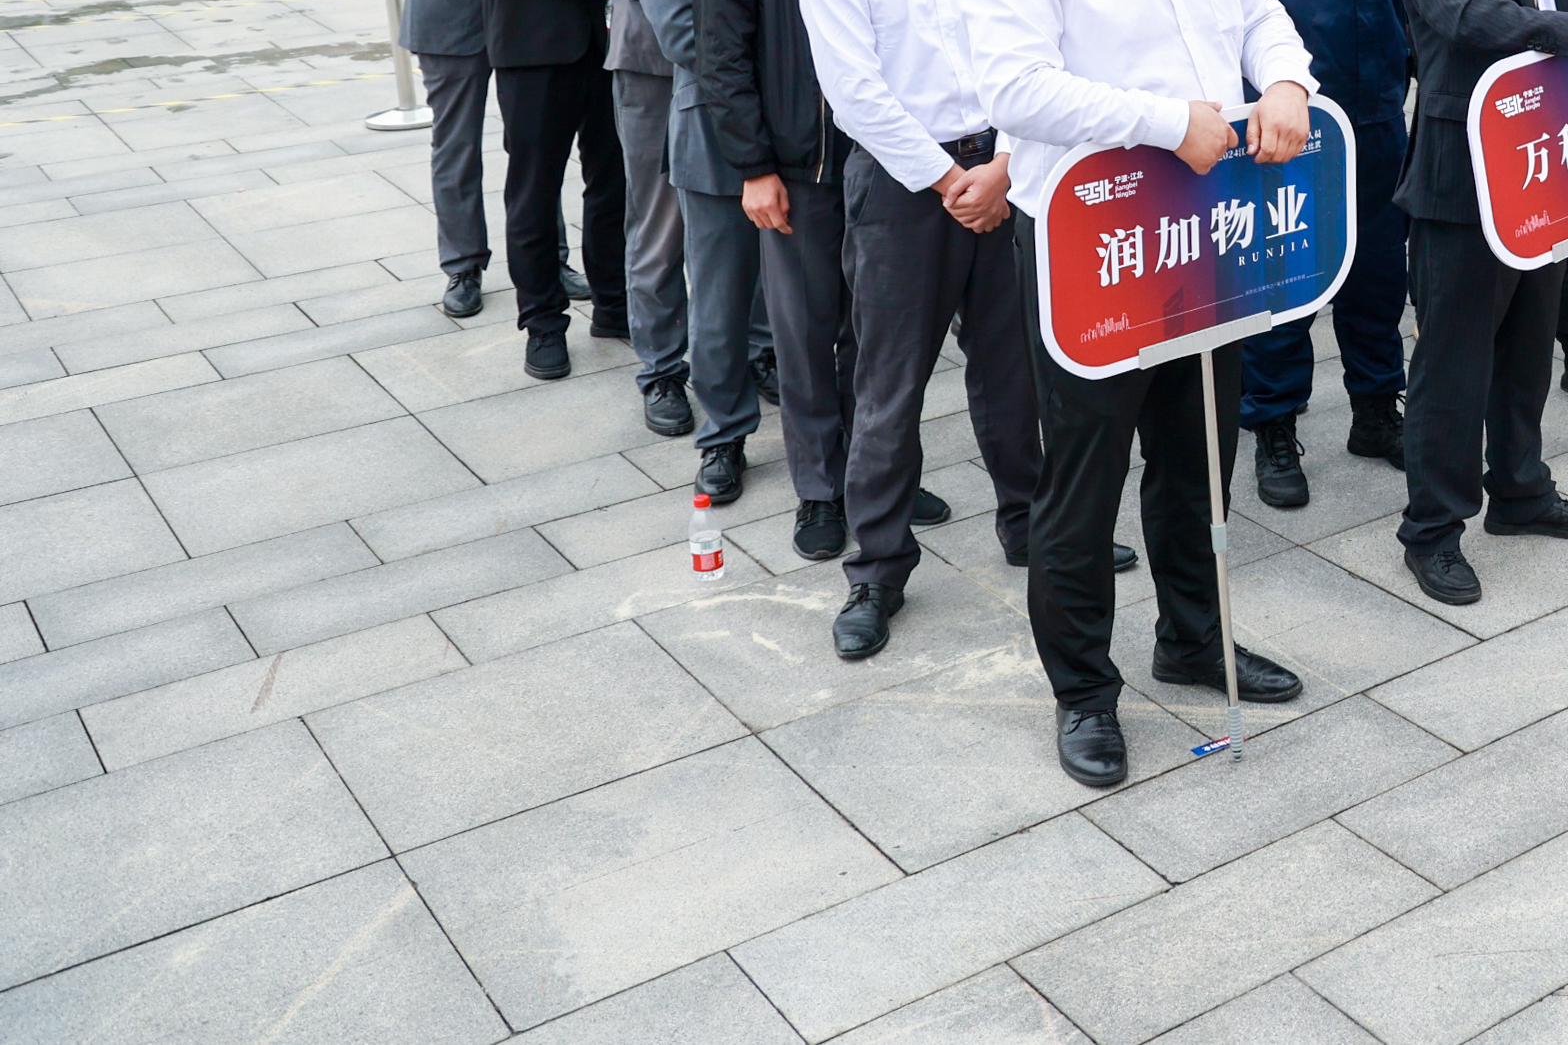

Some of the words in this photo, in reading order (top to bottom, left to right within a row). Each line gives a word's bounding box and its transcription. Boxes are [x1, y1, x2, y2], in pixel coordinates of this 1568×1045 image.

[1115, 189, 1136, 199] Ningbo
[1096, 184, 1308, 287] 润加物业
[1239, 238, 1309, 266] RUNJIA
